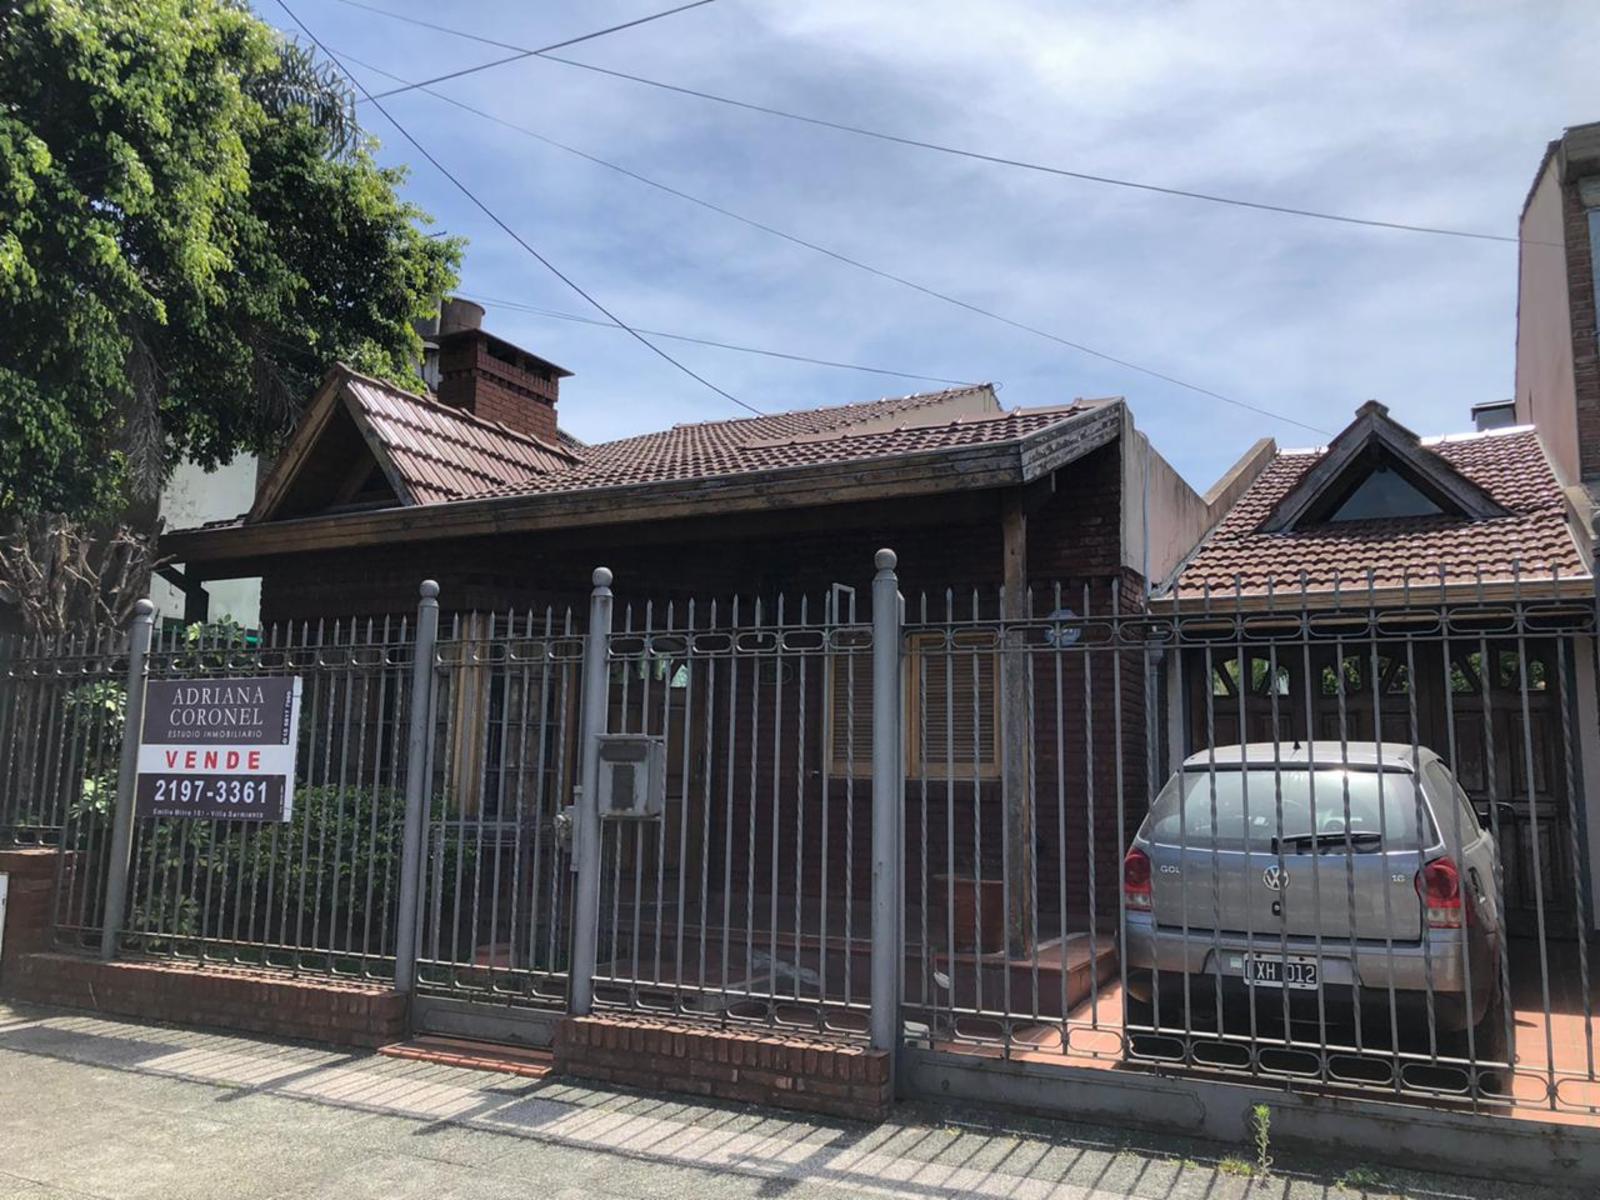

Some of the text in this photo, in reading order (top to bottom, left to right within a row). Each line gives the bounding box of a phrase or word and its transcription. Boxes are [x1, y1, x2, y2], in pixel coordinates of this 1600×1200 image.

[172, 686, 265, 706] ADRIANA
[169, 708, 264, 726] CORONEL
[168, 730, 263, 738] ESTUDIO INMOBILIARIO
[165, 750, 261, 770] VENDE
[154, 779, 267, 804] 2197-3361
[1160, 864, 1180, 874] GOL
[1246, 962, 1276, 981] XH
